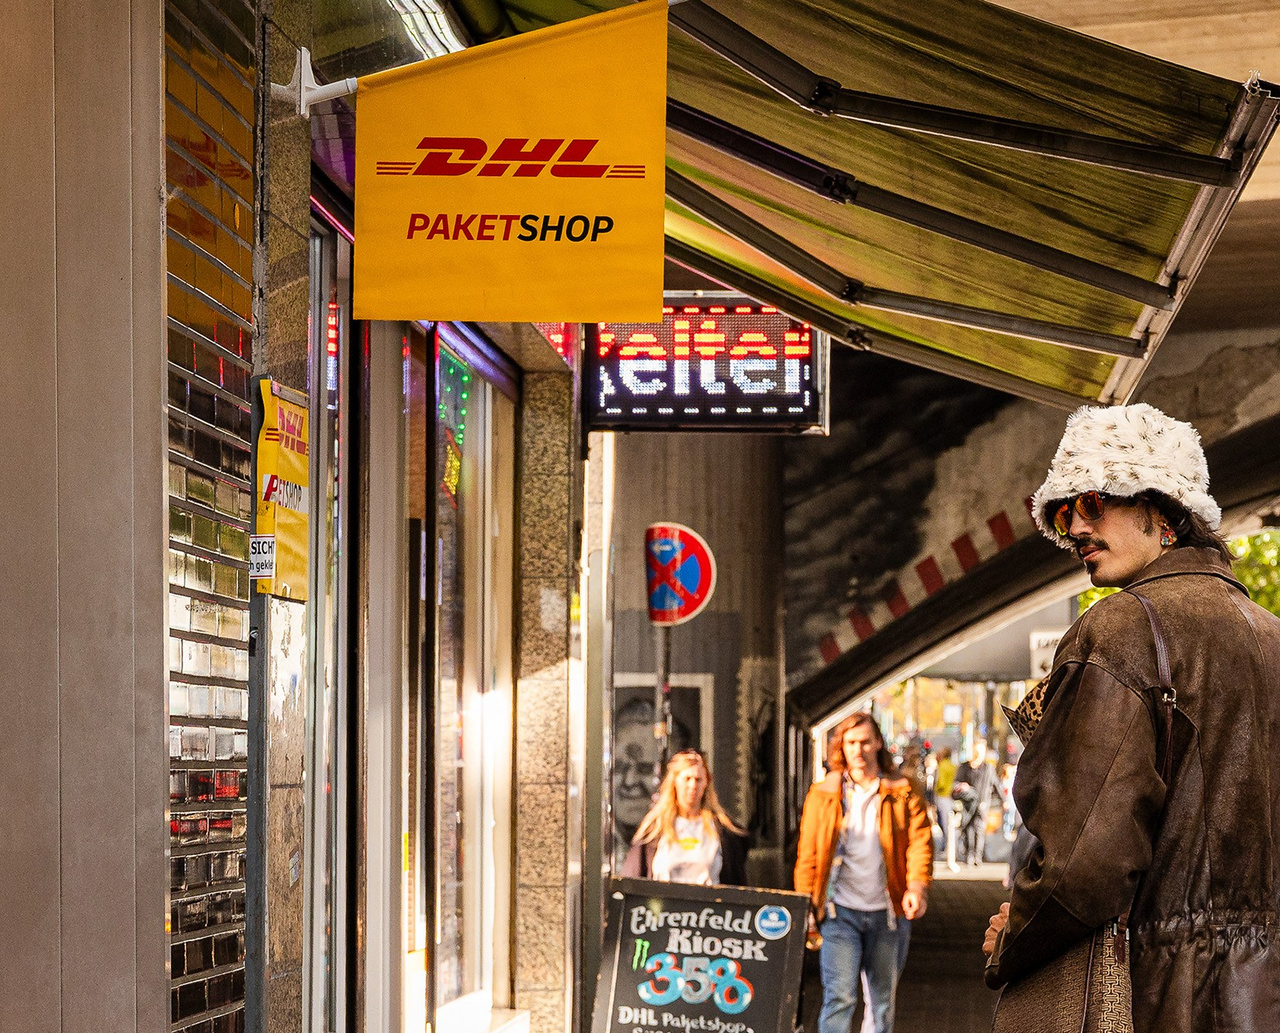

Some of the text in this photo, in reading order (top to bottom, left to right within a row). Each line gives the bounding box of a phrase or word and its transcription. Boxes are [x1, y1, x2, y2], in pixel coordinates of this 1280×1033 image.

[411, 136, 610, 179] DHL
[405, 212, 614, 243] PAKETSHOP
[630, 905, 752, 935] Ehrenfeld
[637, 952, 755, 1015] 358
[618, 1005, 659, 1026] DHL
